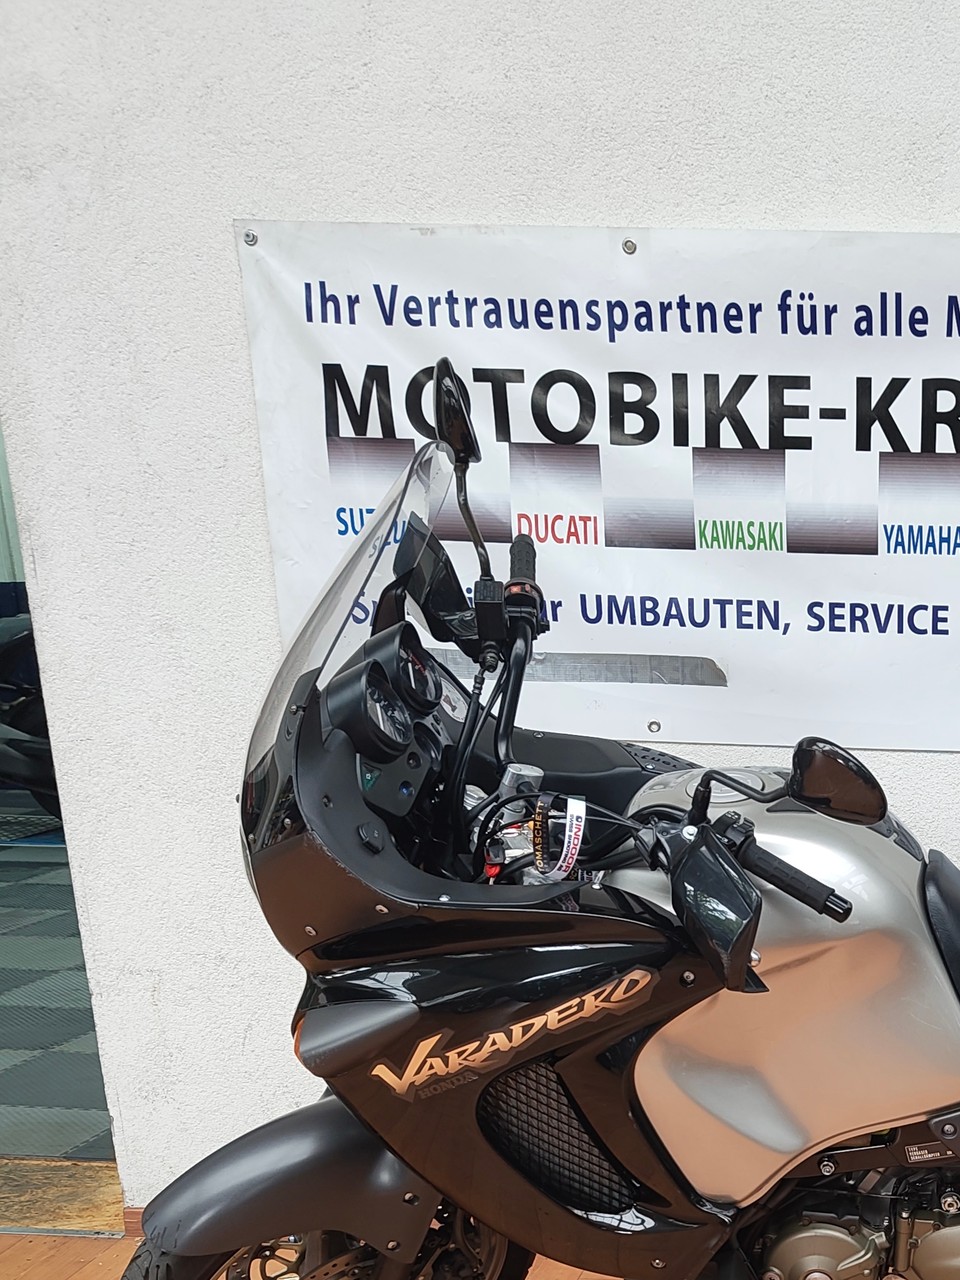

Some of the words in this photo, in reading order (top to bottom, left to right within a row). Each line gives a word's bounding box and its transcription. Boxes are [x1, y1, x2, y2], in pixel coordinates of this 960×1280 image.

[304, 280, 360, 325] Ihr
[372, 283, 763, 343] Vertrauenspartner
[777, 289, 838, 336] für
[853, 291, 929, 338] alle
[517, 513, 598, 546] DUCATI
[698, 519, 784, 552] KAWASAKI
[579, 593, 791, 636] UMBAUTEN,
[806, 601, 950, 636] SERVICE
[562, 823, 582, 873] INDOOR
[371, 969, 652, 1095] VARADERO
[419, 1071, 479, 1099] HONDA
